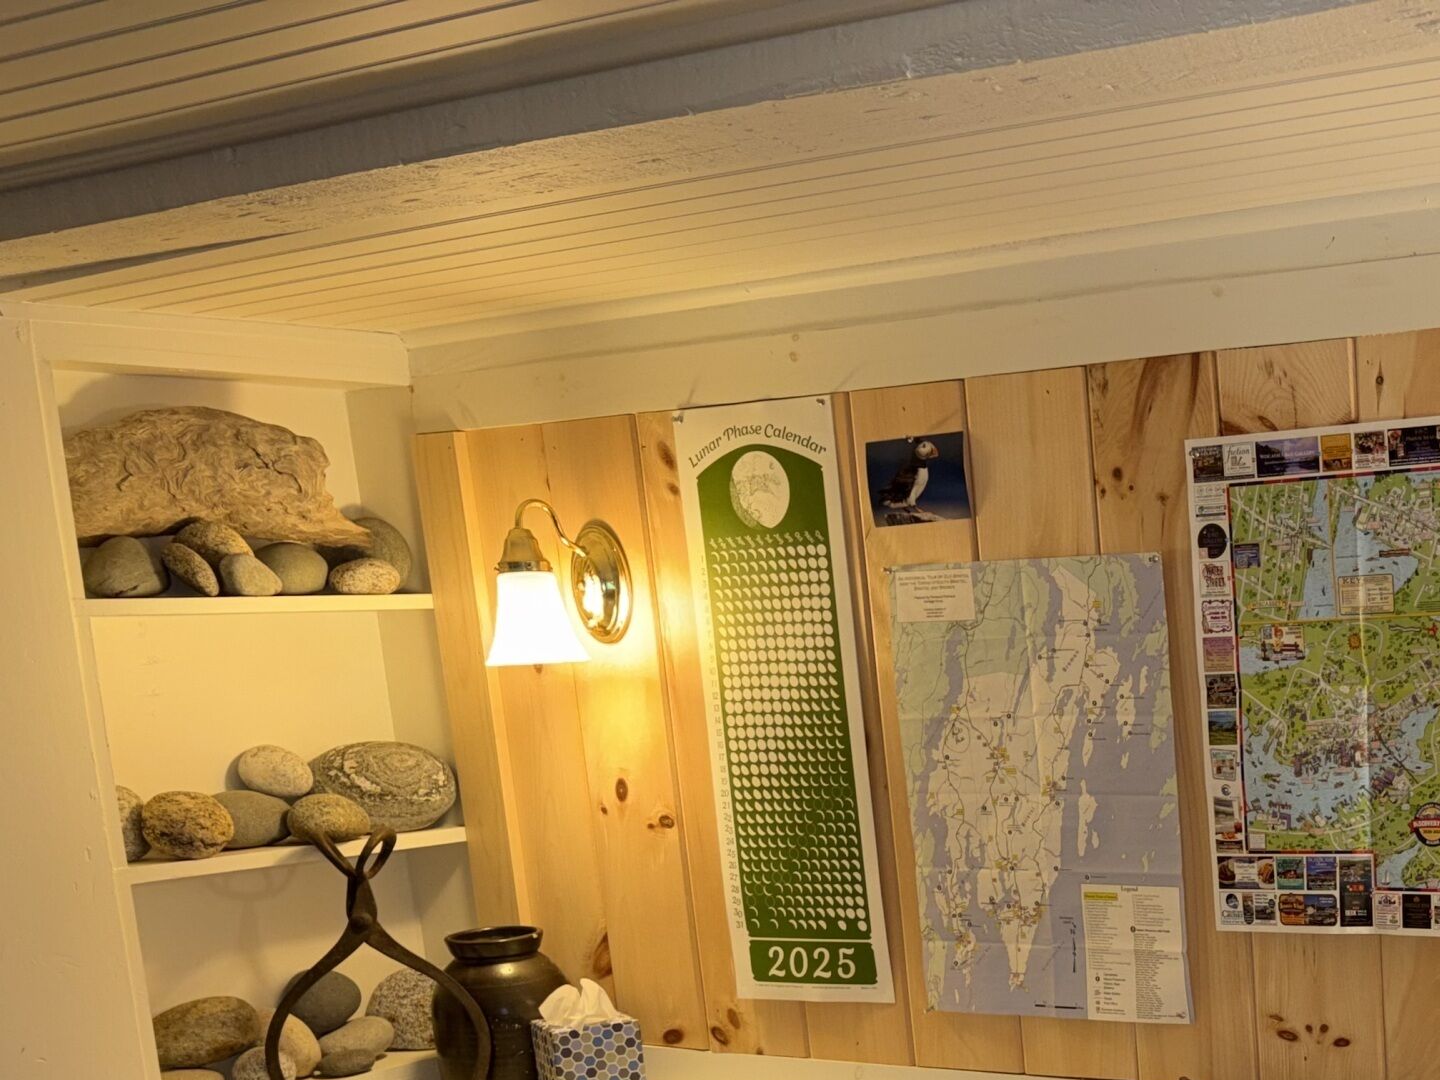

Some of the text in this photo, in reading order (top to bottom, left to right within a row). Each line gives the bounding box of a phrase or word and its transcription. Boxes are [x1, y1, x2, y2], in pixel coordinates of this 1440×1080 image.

[688, 423, 827, 468] Lunar Phase Calendar
[768, 946, 856, 979] 2025
